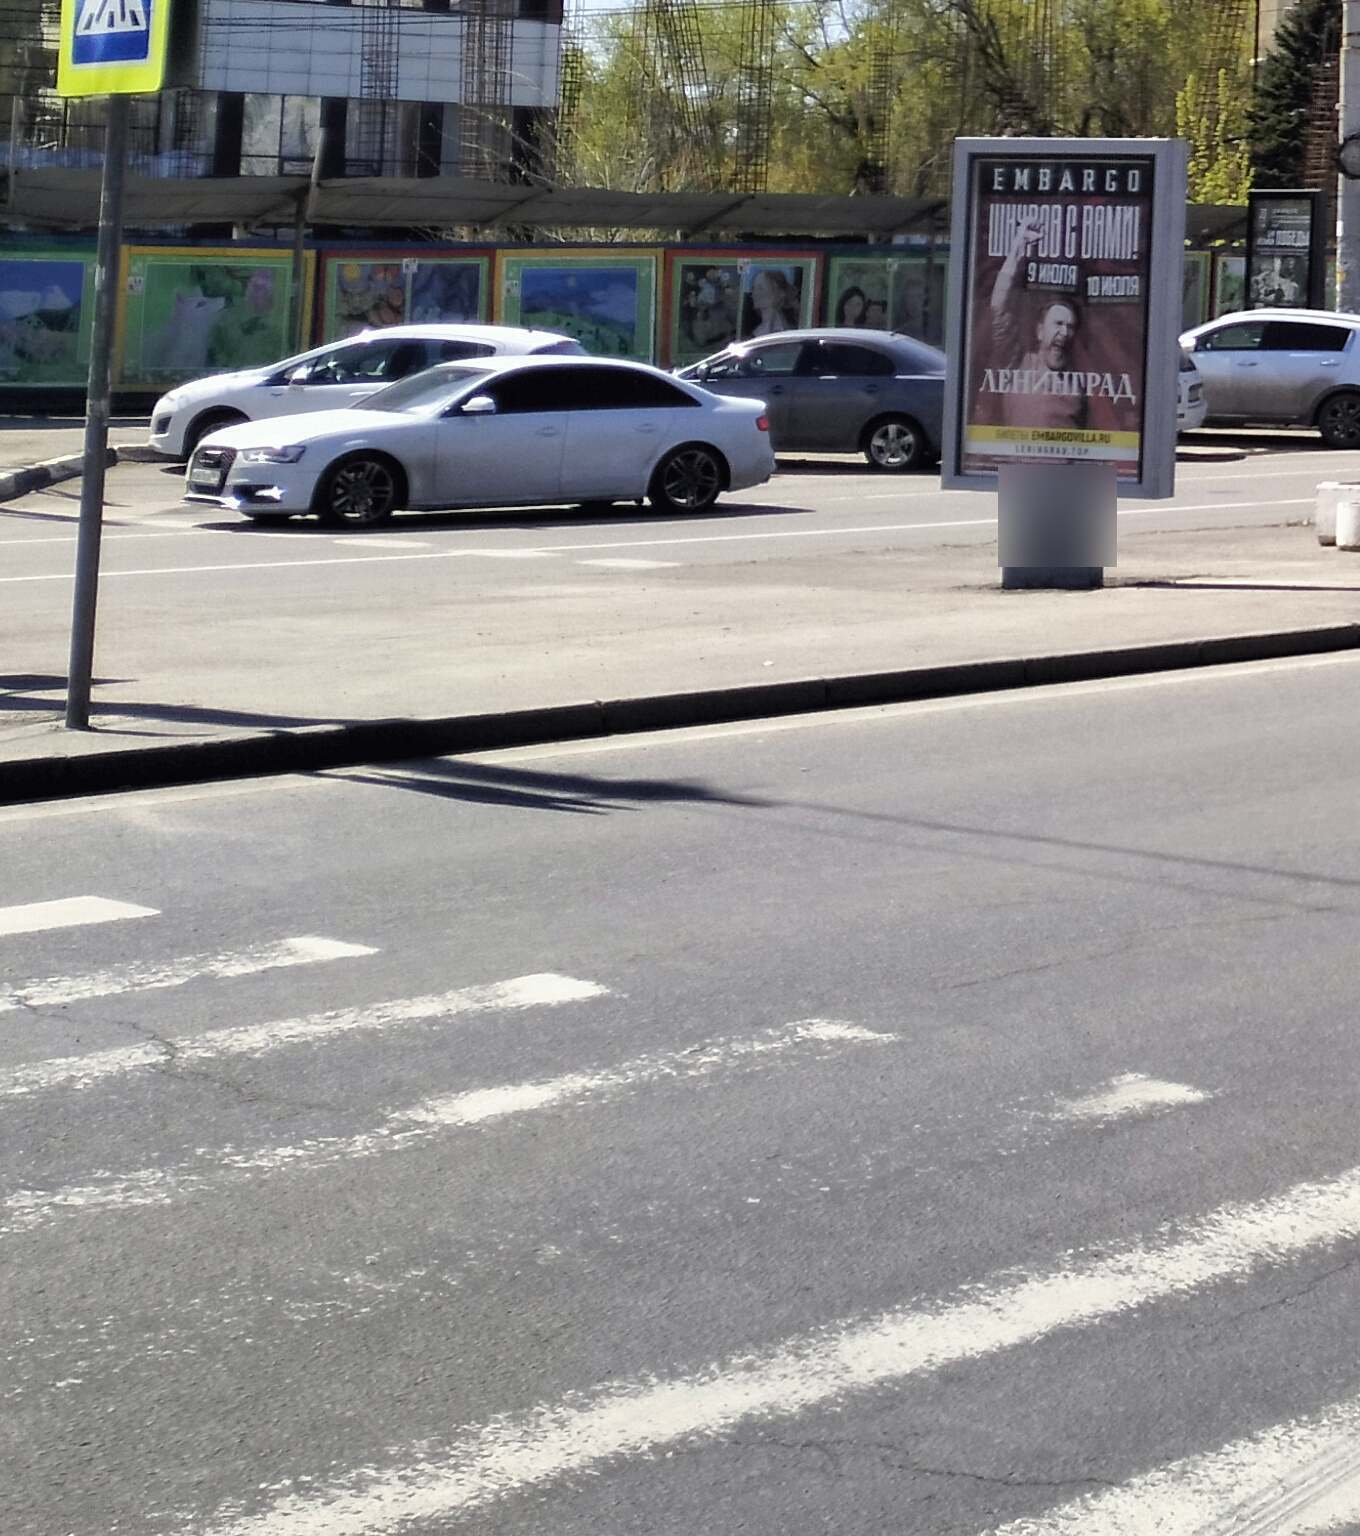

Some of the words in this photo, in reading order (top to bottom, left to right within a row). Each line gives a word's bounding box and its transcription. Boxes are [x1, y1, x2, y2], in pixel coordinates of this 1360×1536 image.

[992, 168, 1141, 192] EMBARGO
[1064, 204, 1078, 258] С
[1080, 204, 1141, 260] ВАМИ!
[1027, 262, 1038, 282] 9
[1039, 264, 1078, 285] ИЮЛЯ
[1086, 276, 1100, 296] 10
[1101, 275, 1141, 296] ИЮЛЯ
[979, 368, 1137, 406] ЛЕНИНГРАД
